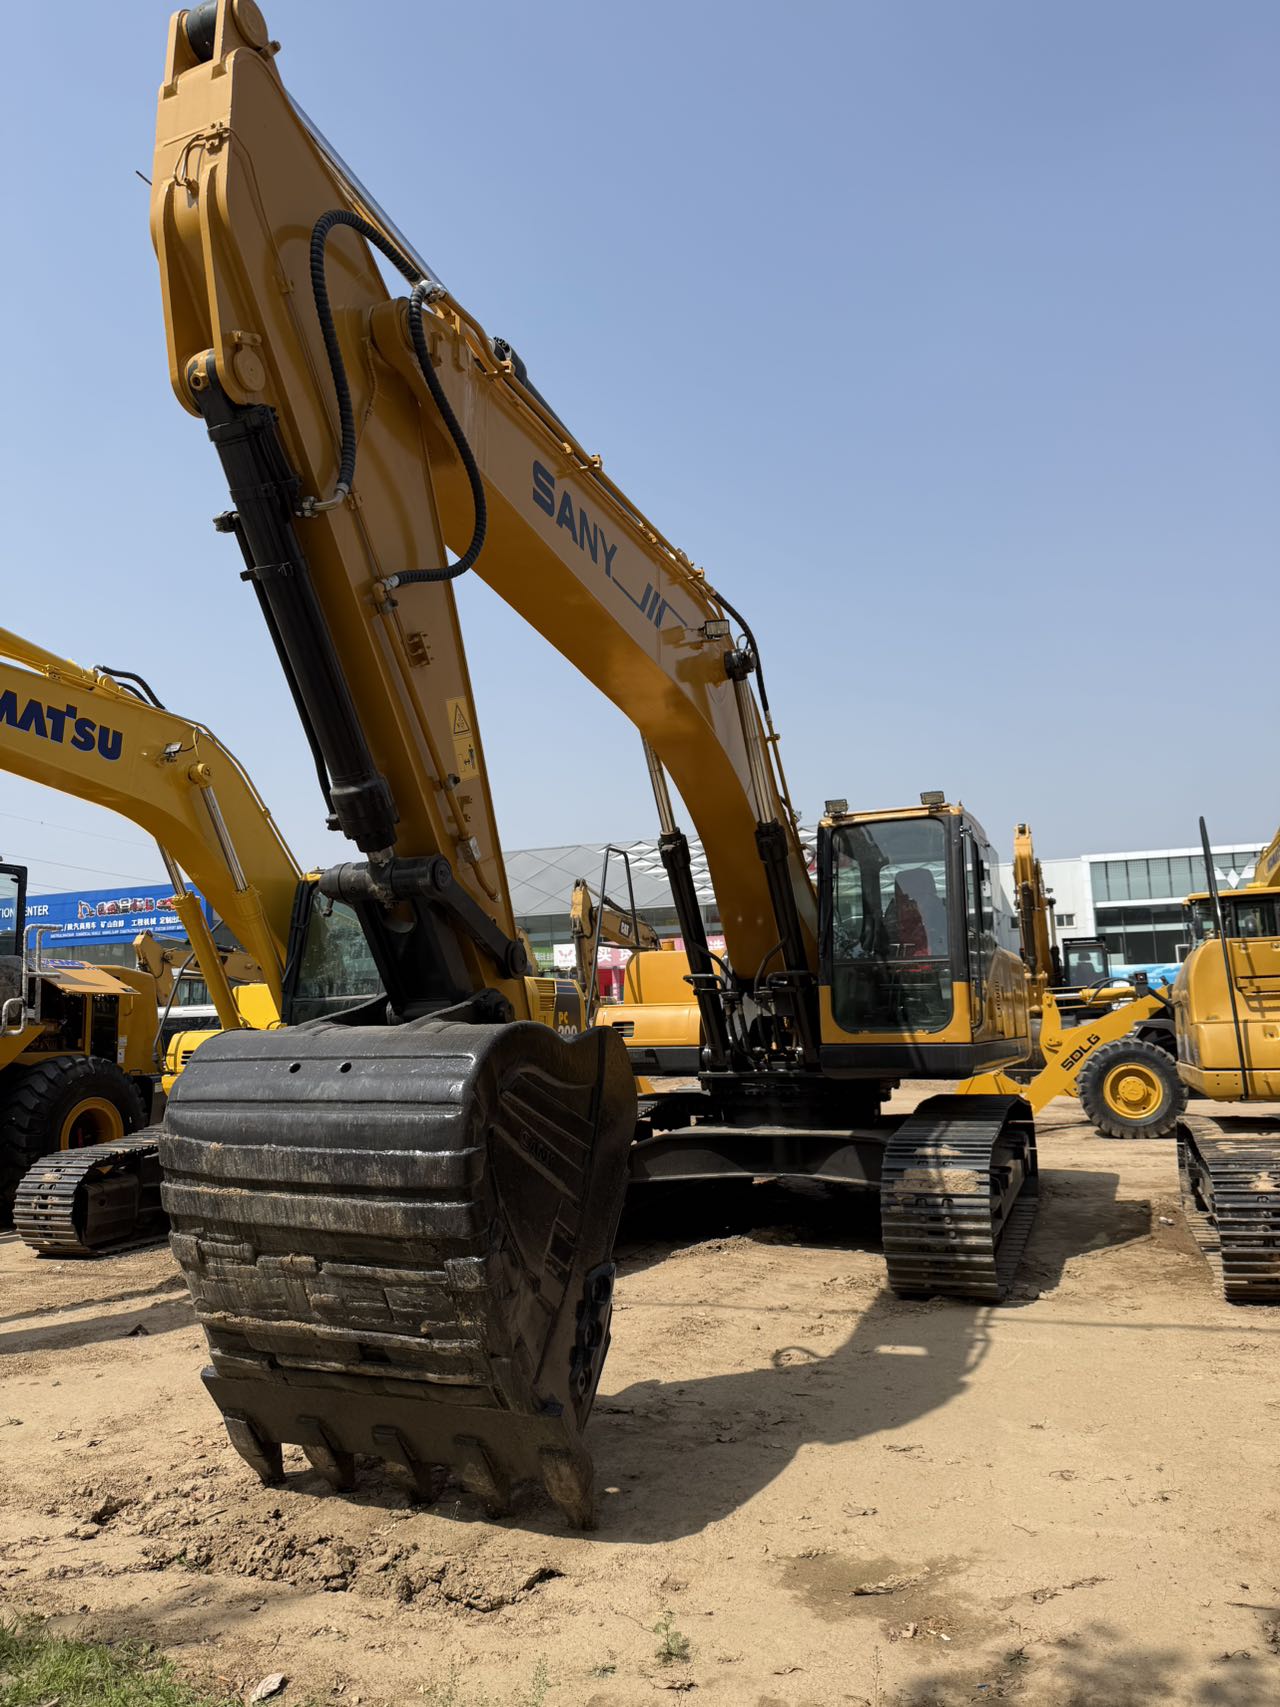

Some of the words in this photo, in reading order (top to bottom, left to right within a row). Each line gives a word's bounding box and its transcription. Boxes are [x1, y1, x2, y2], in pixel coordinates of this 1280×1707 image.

[533, 460, 617, 579] SANY
[559, 1011, 568, 1024] PC
[1060, 1034, 1101, 1071] SDLG
